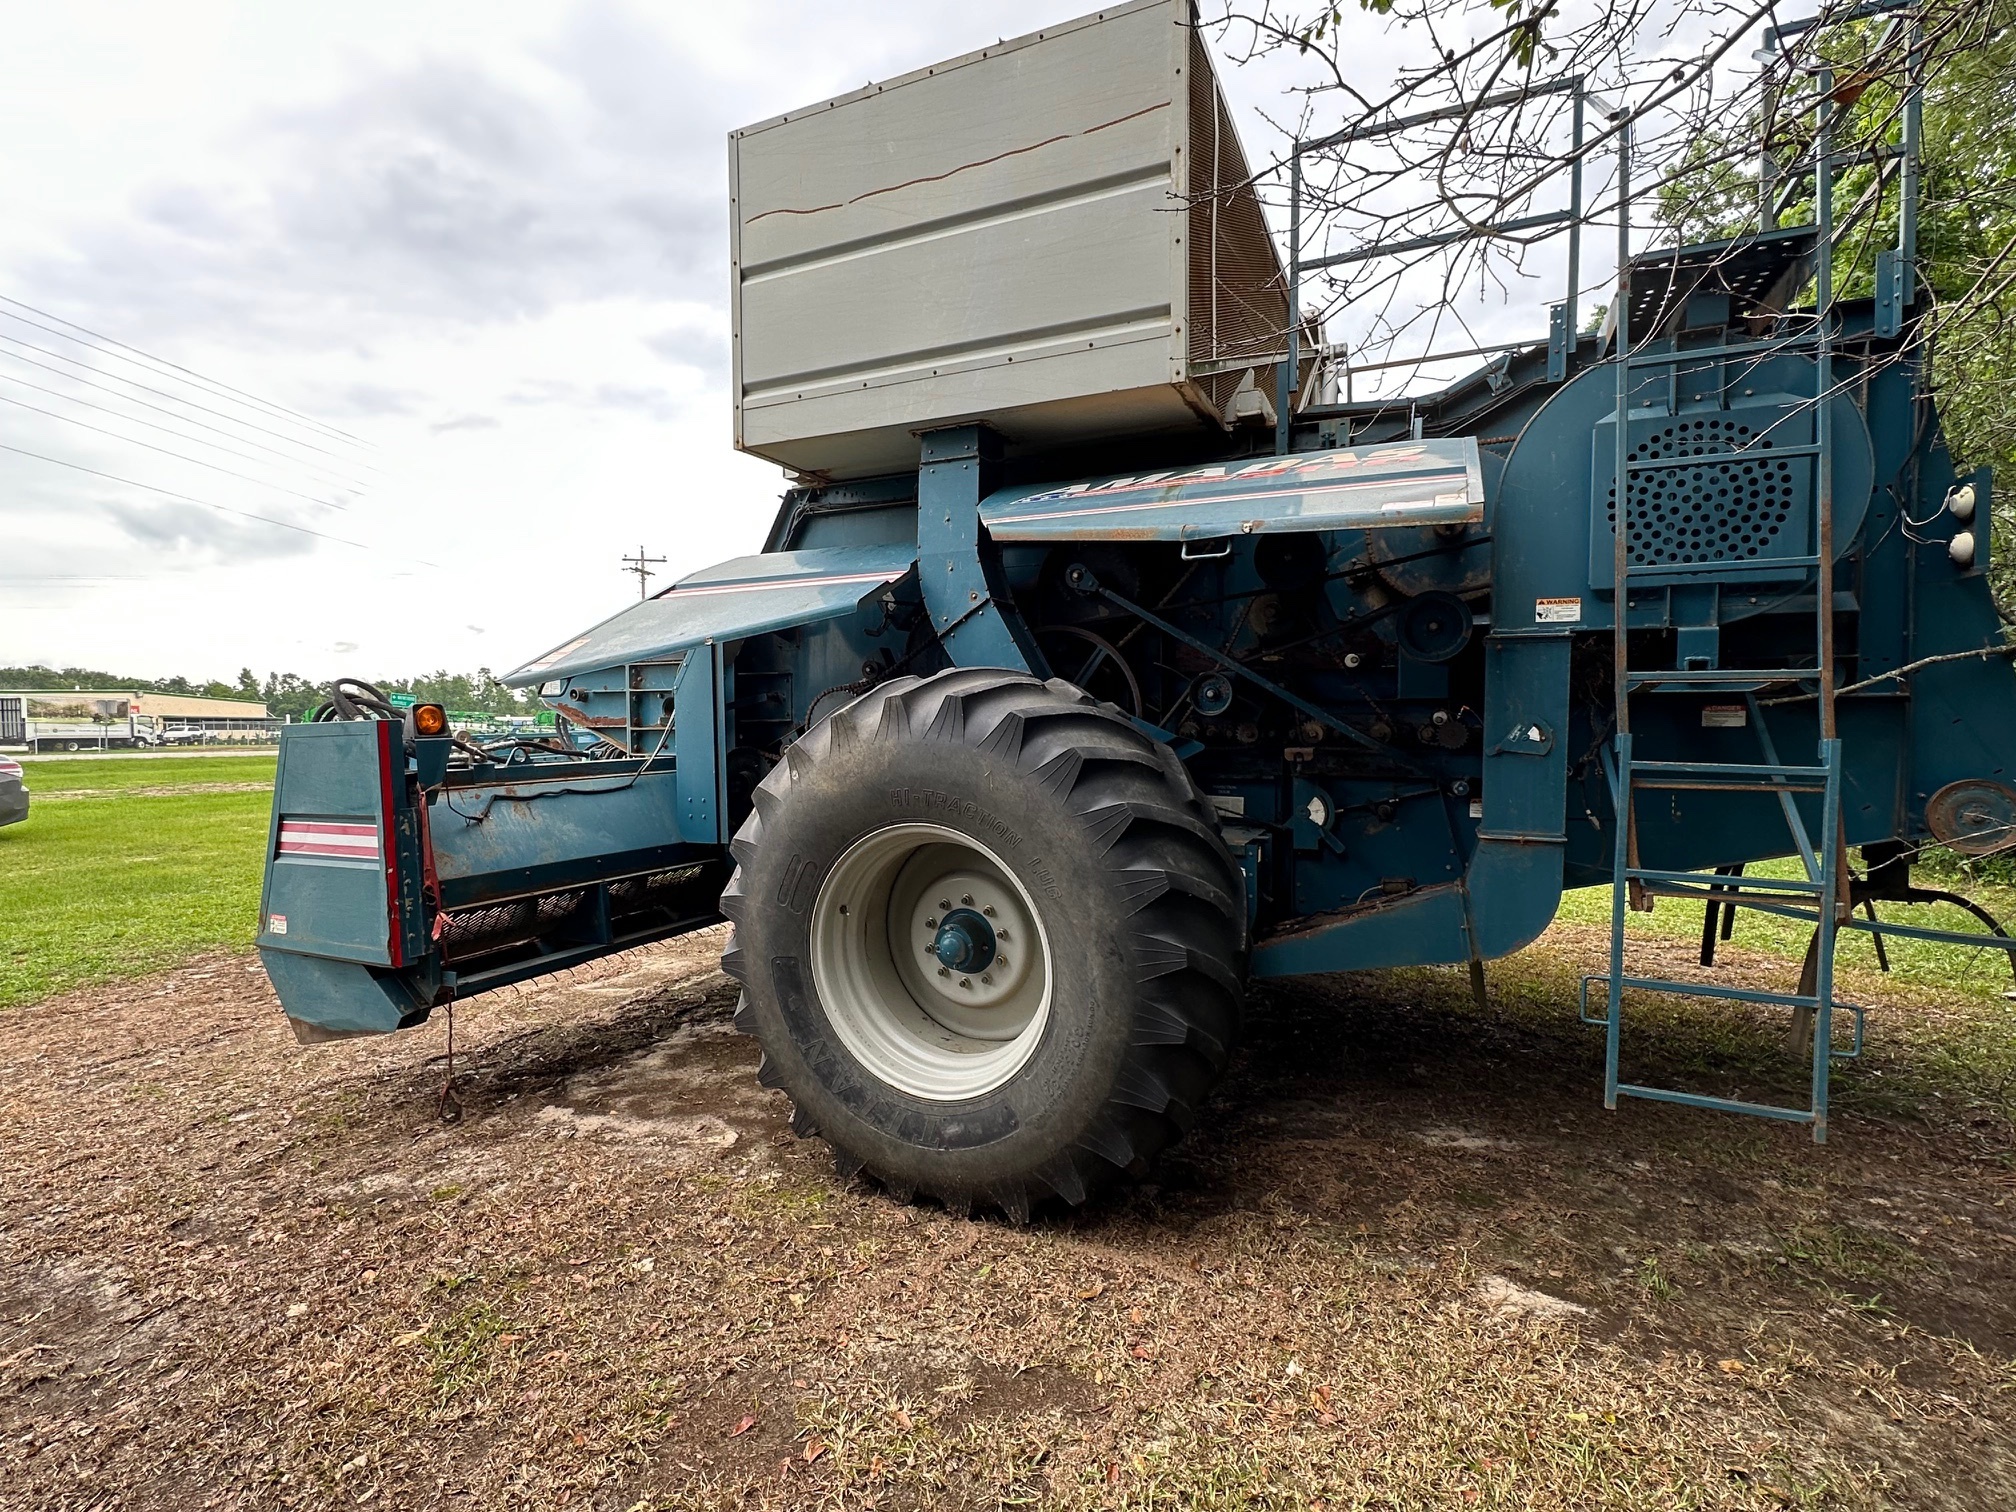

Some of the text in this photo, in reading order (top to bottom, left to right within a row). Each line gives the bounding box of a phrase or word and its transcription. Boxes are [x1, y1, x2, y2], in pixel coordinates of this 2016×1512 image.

[1546, 598, 1580, 606] WARNING
[889, 788, 1063, 901] HI-TRACTION LUG
[801, 1037, 943, 1149] TITAN
